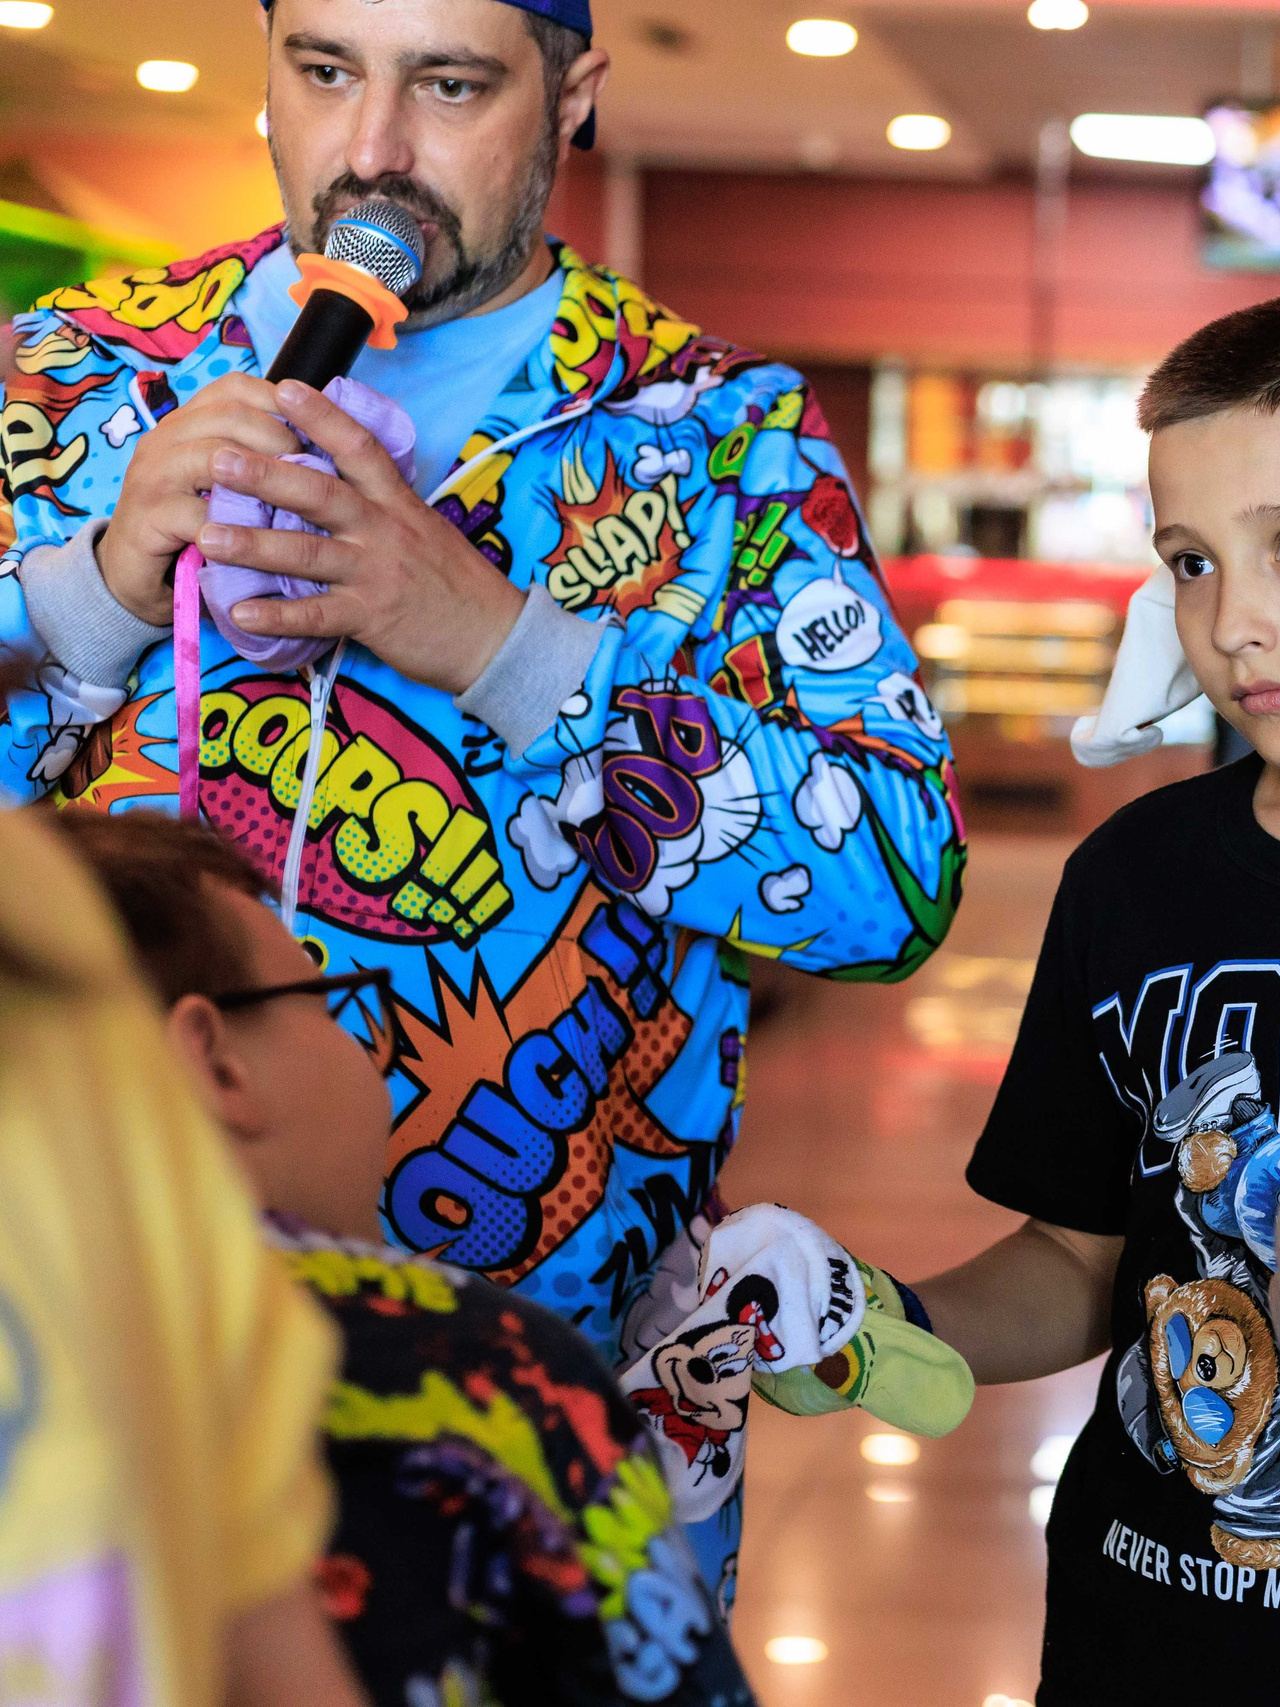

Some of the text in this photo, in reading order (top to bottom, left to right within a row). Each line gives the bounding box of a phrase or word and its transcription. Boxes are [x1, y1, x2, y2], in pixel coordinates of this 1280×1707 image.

[547, 476, 693, 609] SLAP!
[792, 600, 865, 662] HELLO!
[1102, 1518, 1171, 1585] NEVER
[1179, 1553, 1255, 1603] STOP
